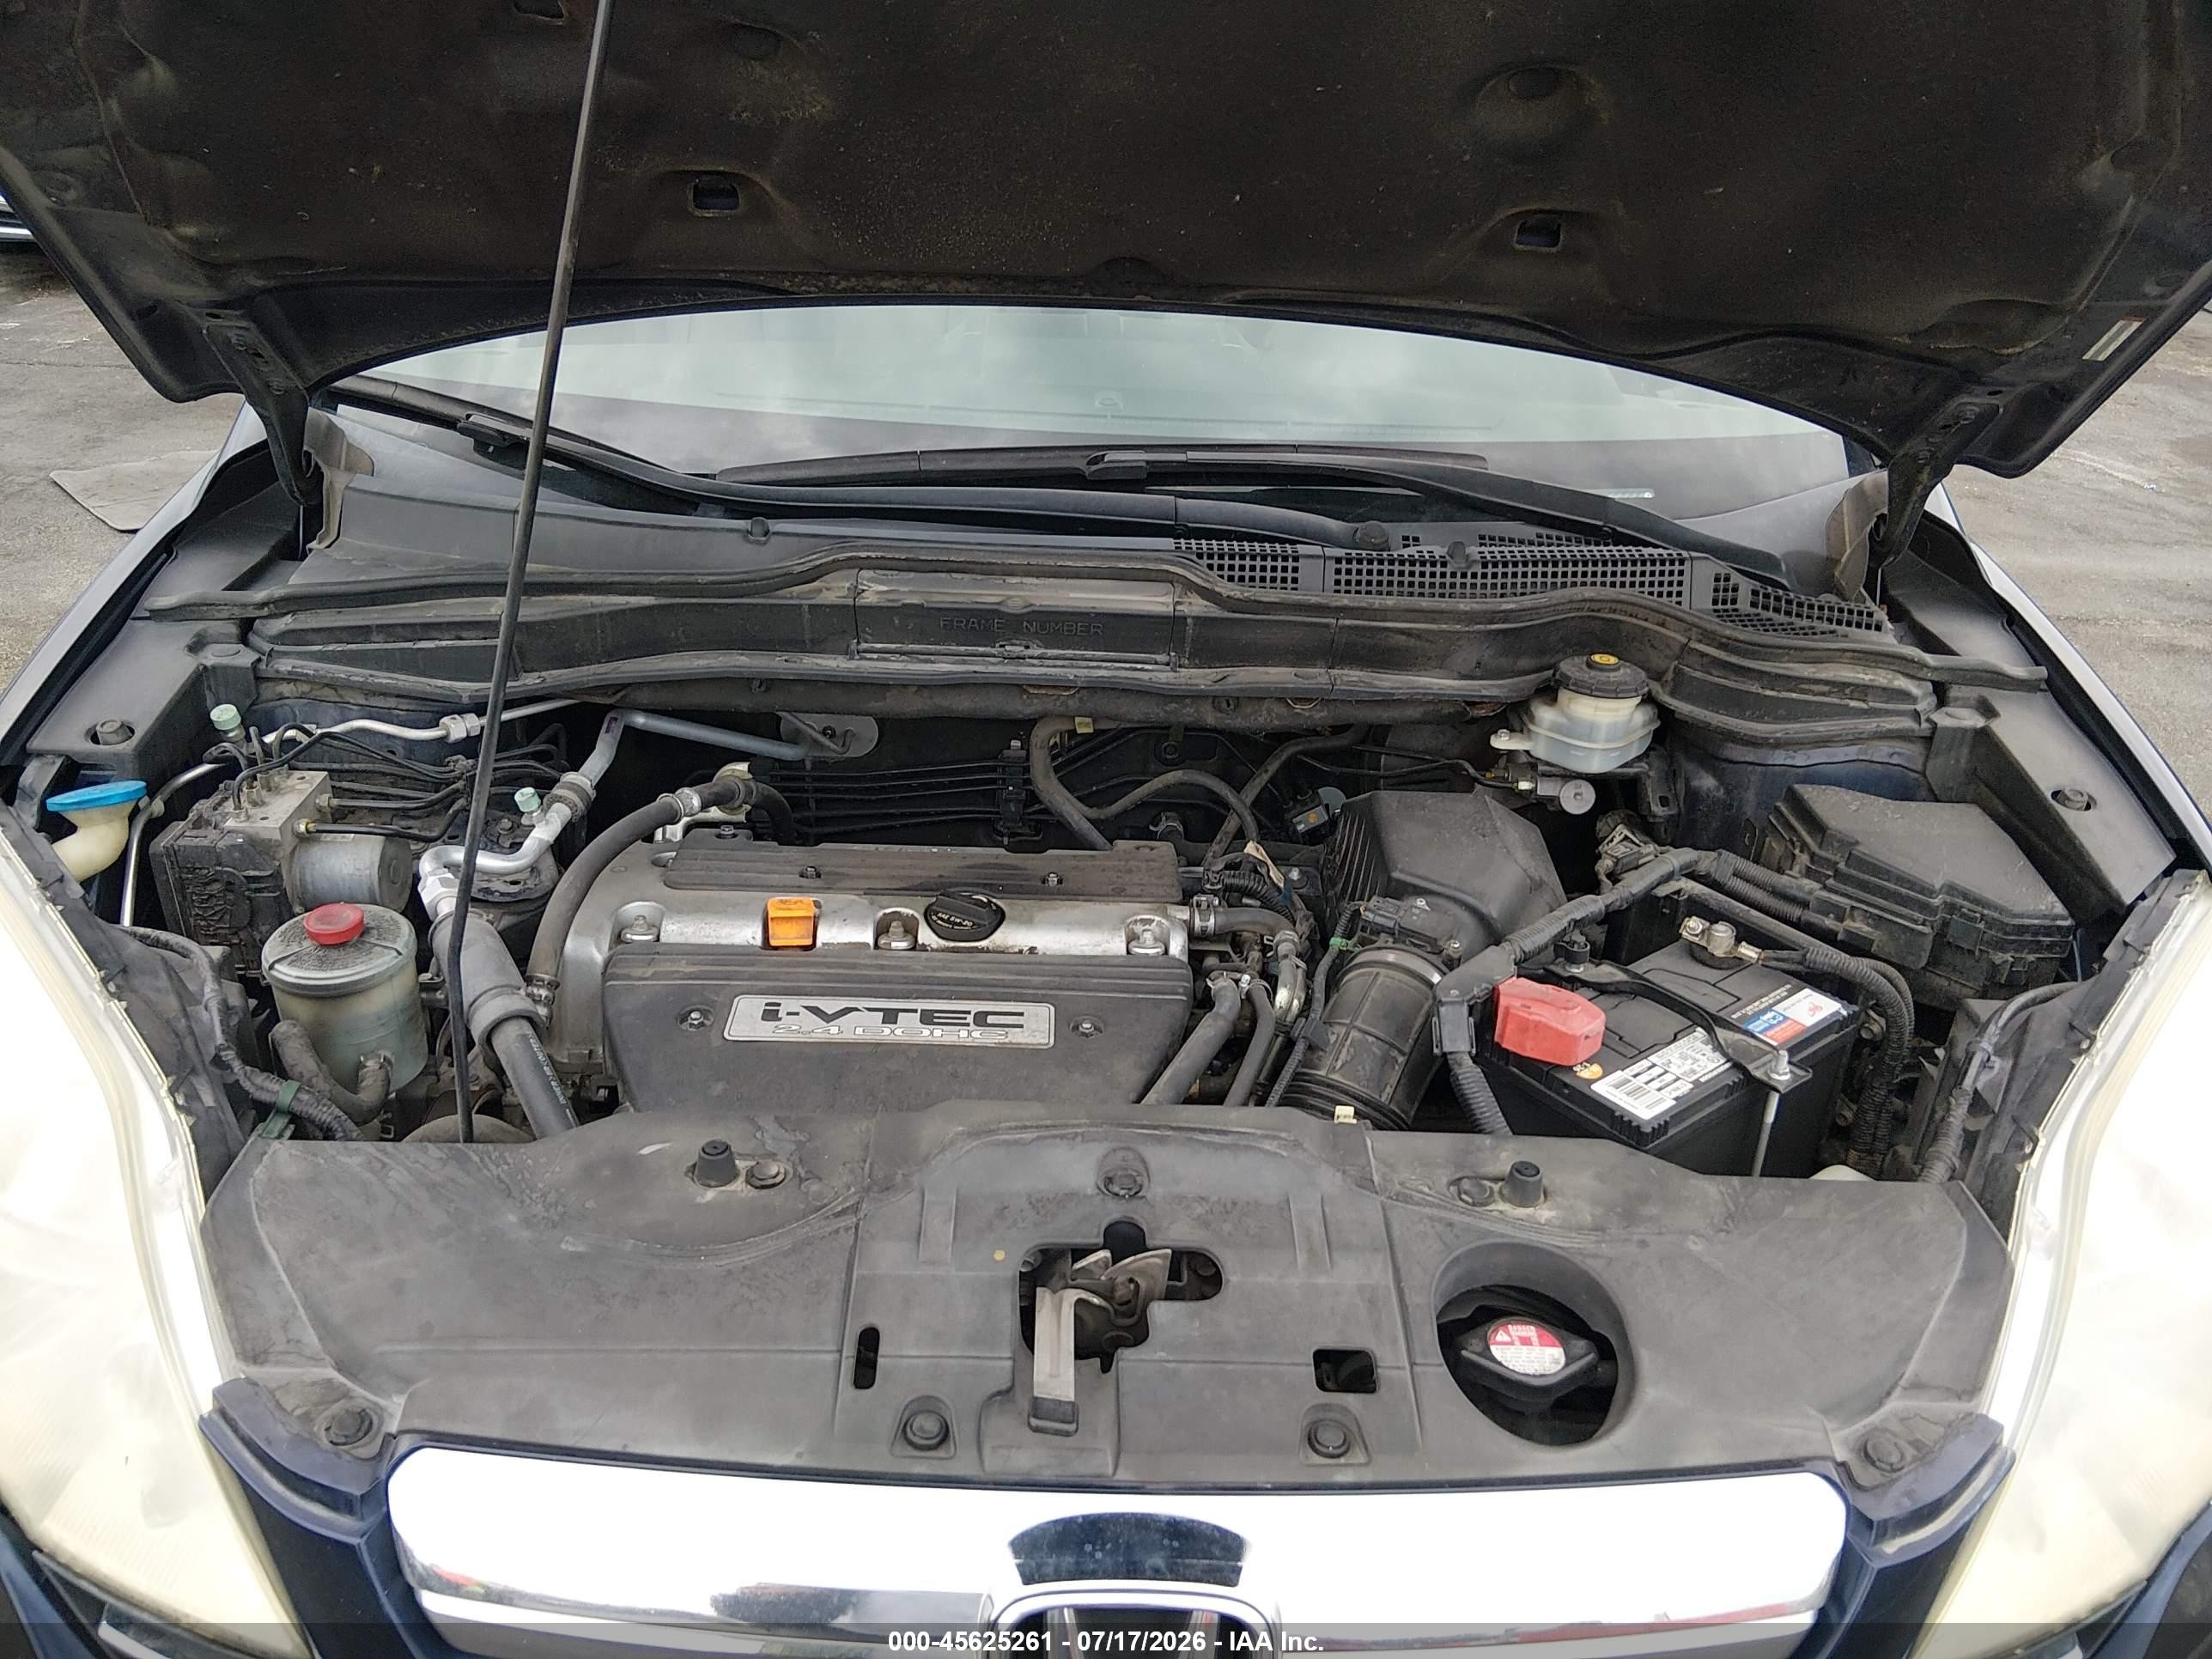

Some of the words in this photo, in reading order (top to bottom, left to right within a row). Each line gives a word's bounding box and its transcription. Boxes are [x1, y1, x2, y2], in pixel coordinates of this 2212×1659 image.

[940, 617, 1006, 632] FRAME
[1023, 620, 1103, 635] NUMBER
[761, 1001, 1024, 1029] i-VTEC
[773, 1024, 842, 1036] 2.4
[854, 1026, 1009, 1040] DOHC
